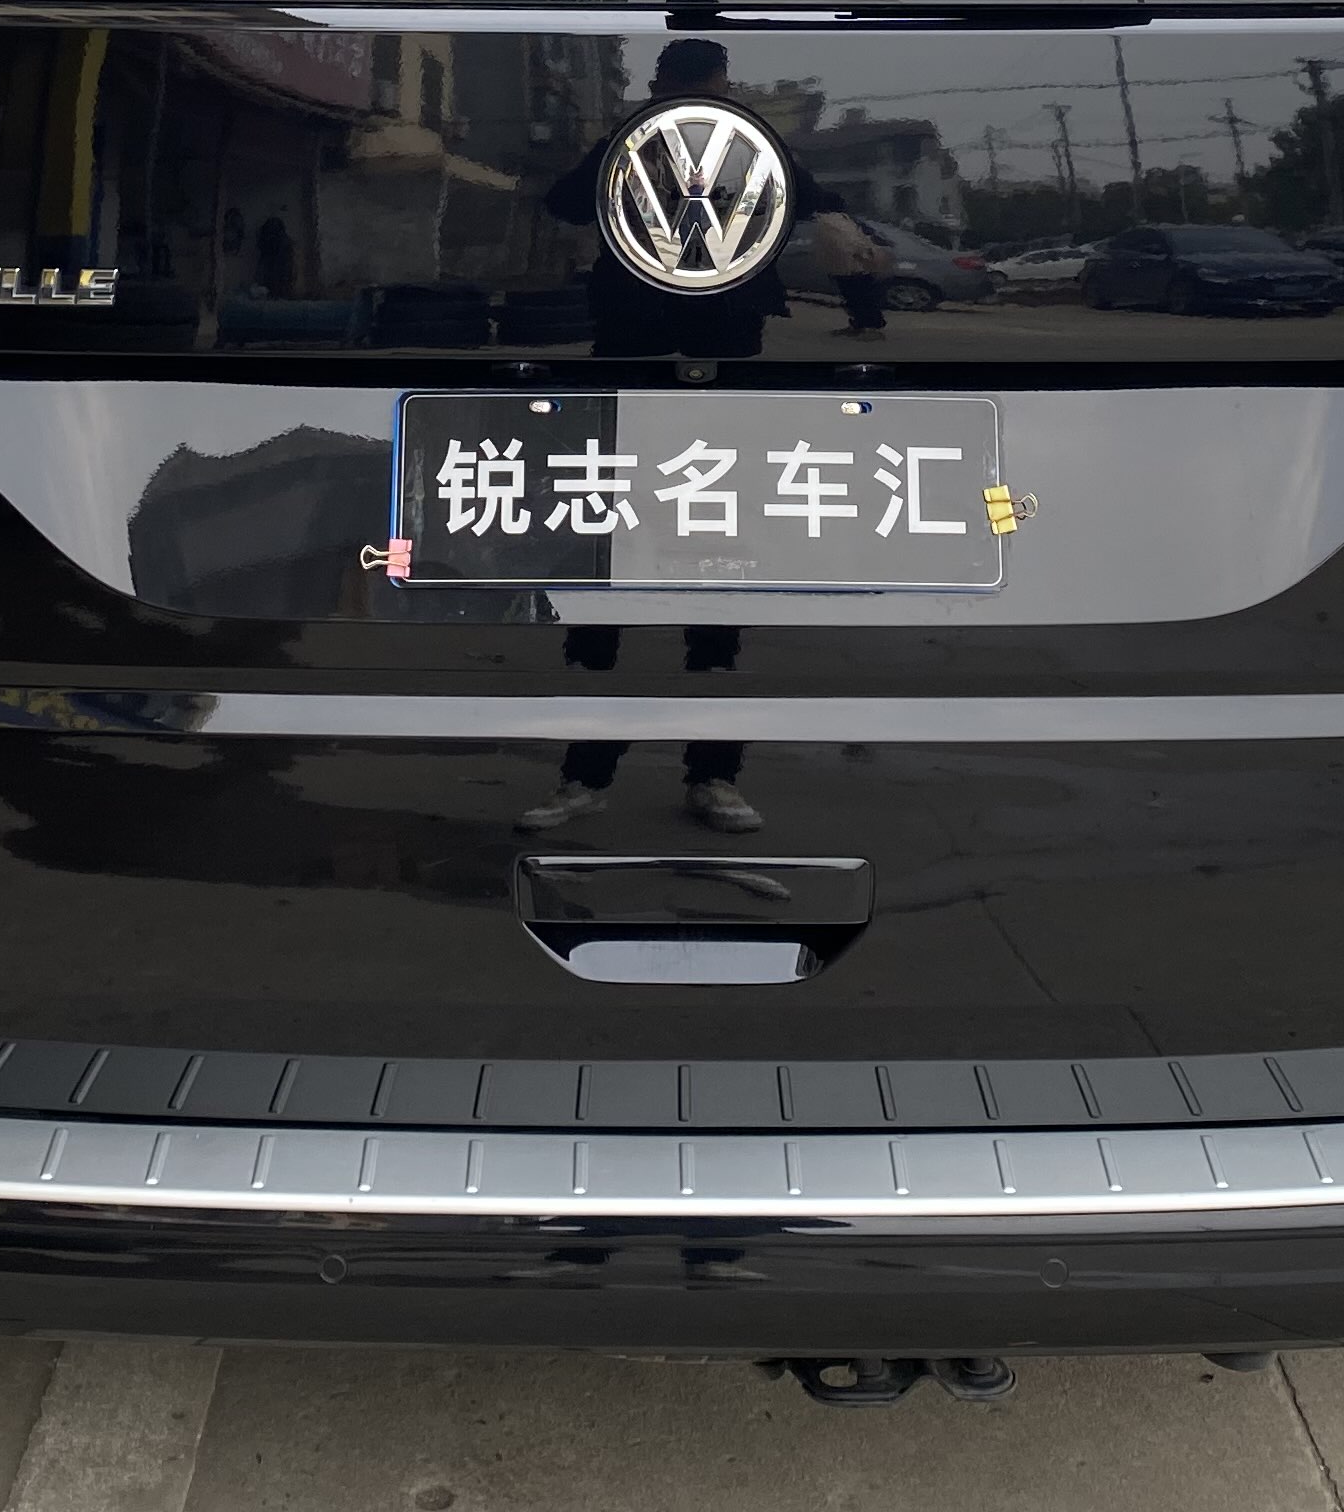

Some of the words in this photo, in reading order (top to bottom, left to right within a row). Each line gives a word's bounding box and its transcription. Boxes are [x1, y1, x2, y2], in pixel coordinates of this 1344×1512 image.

[436, 439, 967, 538] 锐志名车汇
